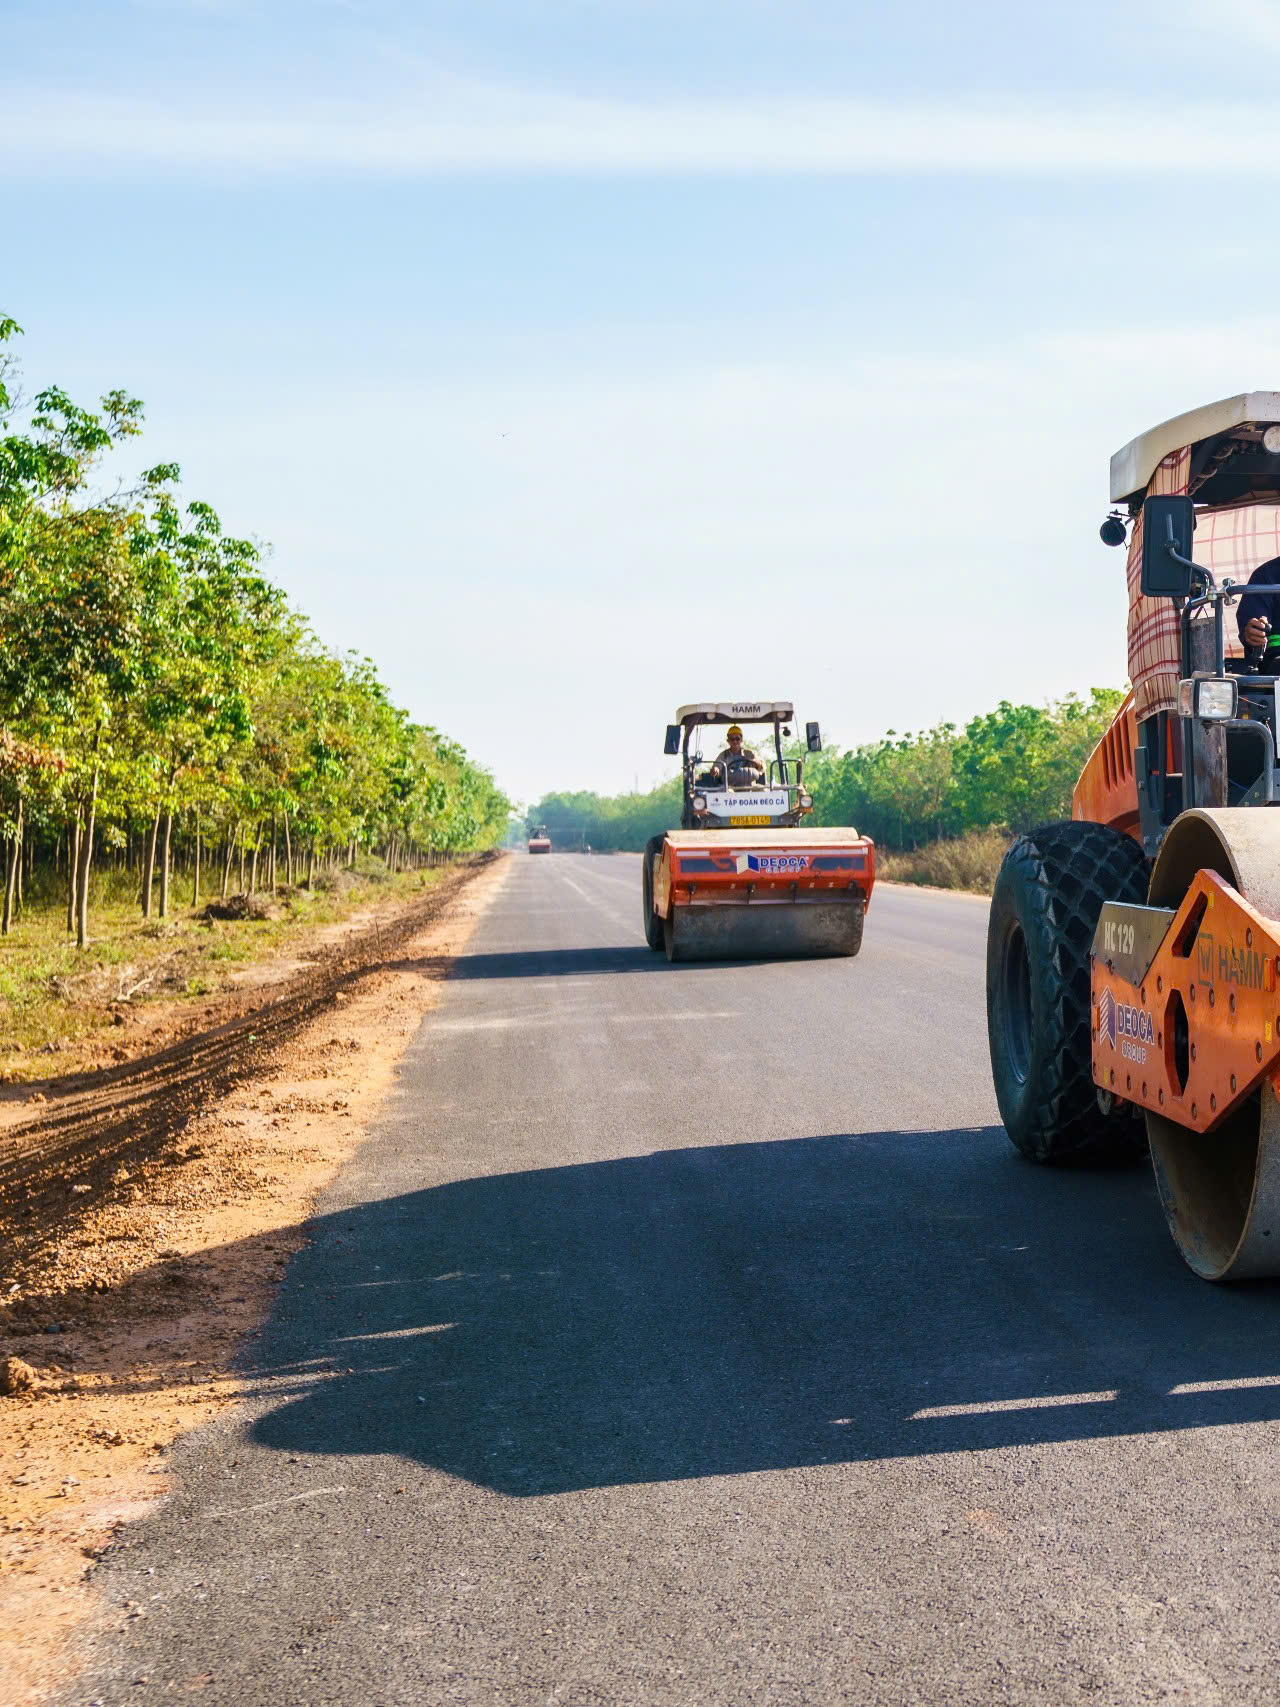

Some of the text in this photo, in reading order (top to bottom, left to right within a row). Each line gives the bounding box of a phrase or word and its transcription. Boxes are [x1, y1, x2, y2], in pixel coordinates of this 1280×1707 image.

[732, 705, 761, 713] HAMM
[760, 856, 808, 868] DEOCA
[1104, 921, 1135, 955] HC 129
[1217, 944, 1267, 990] HAMM
[1116, 1002, 1155, 1046] DEOCA
[1121, 1039, 1147, 1065] GROUP
